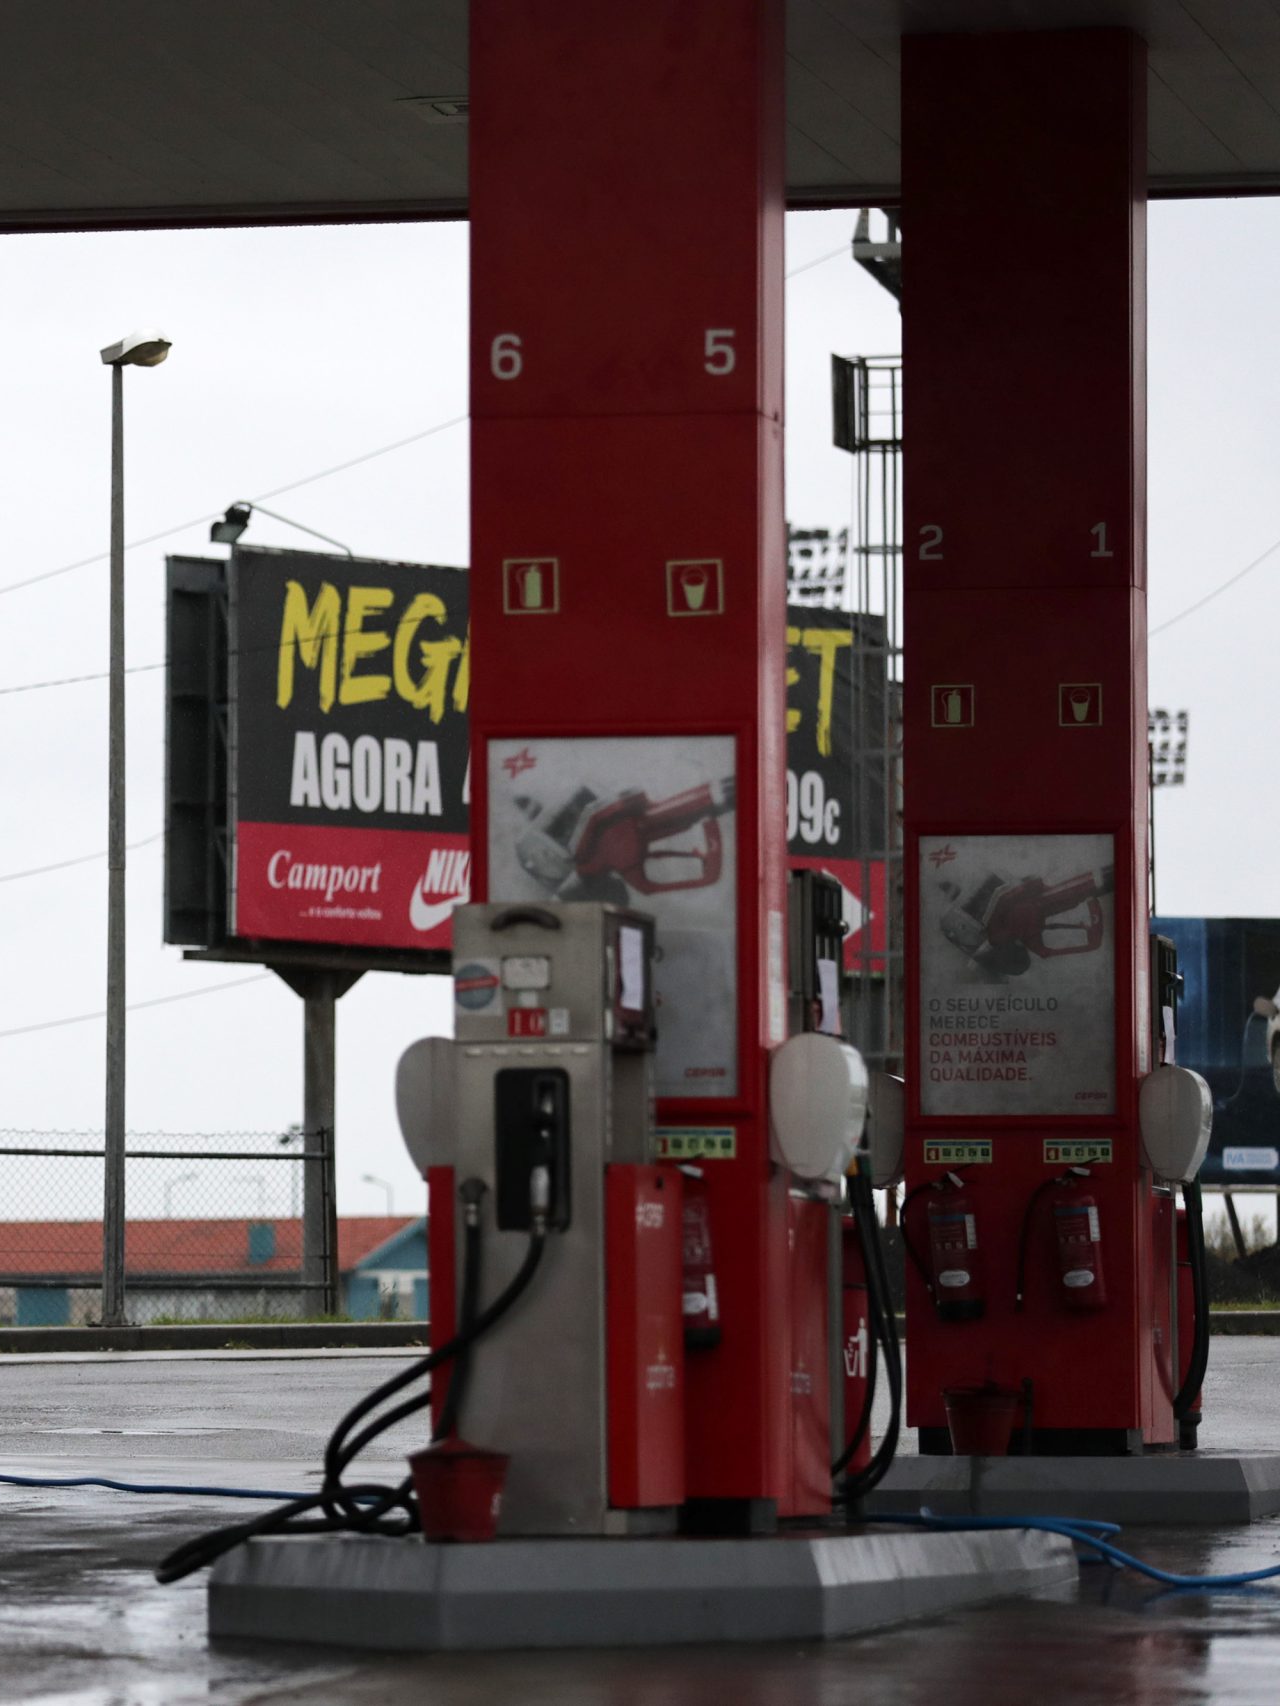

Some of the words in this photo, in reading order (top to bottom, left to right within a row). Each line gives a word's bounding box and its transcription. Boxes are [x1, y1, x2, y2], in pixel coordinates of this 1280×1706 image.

[490, 334, 522, 380] 6
[704, 329, 736, 375] 5
[919, 525, 944, 560] 2
[1089, 522, 1114, 558] 1
[290, 731, 442, 816] AGORA
[267, 849, 382, 902] Camport
[929, 998, 941, 1012] O
[948, 998, 980, 1012] SEU
[985, 994, 1059, 1012] VEÍCULO
[929, 1016, 1000, 1030] MERECE
[929, 1029, 1057, 1046] COMBUSTÍVEIS
[929, 1050, 953, 1064] DA
[959, 1047, 1027, 1064] MÁXIMA
[929, 1067, 1033, 1082] QUALIDADE.
